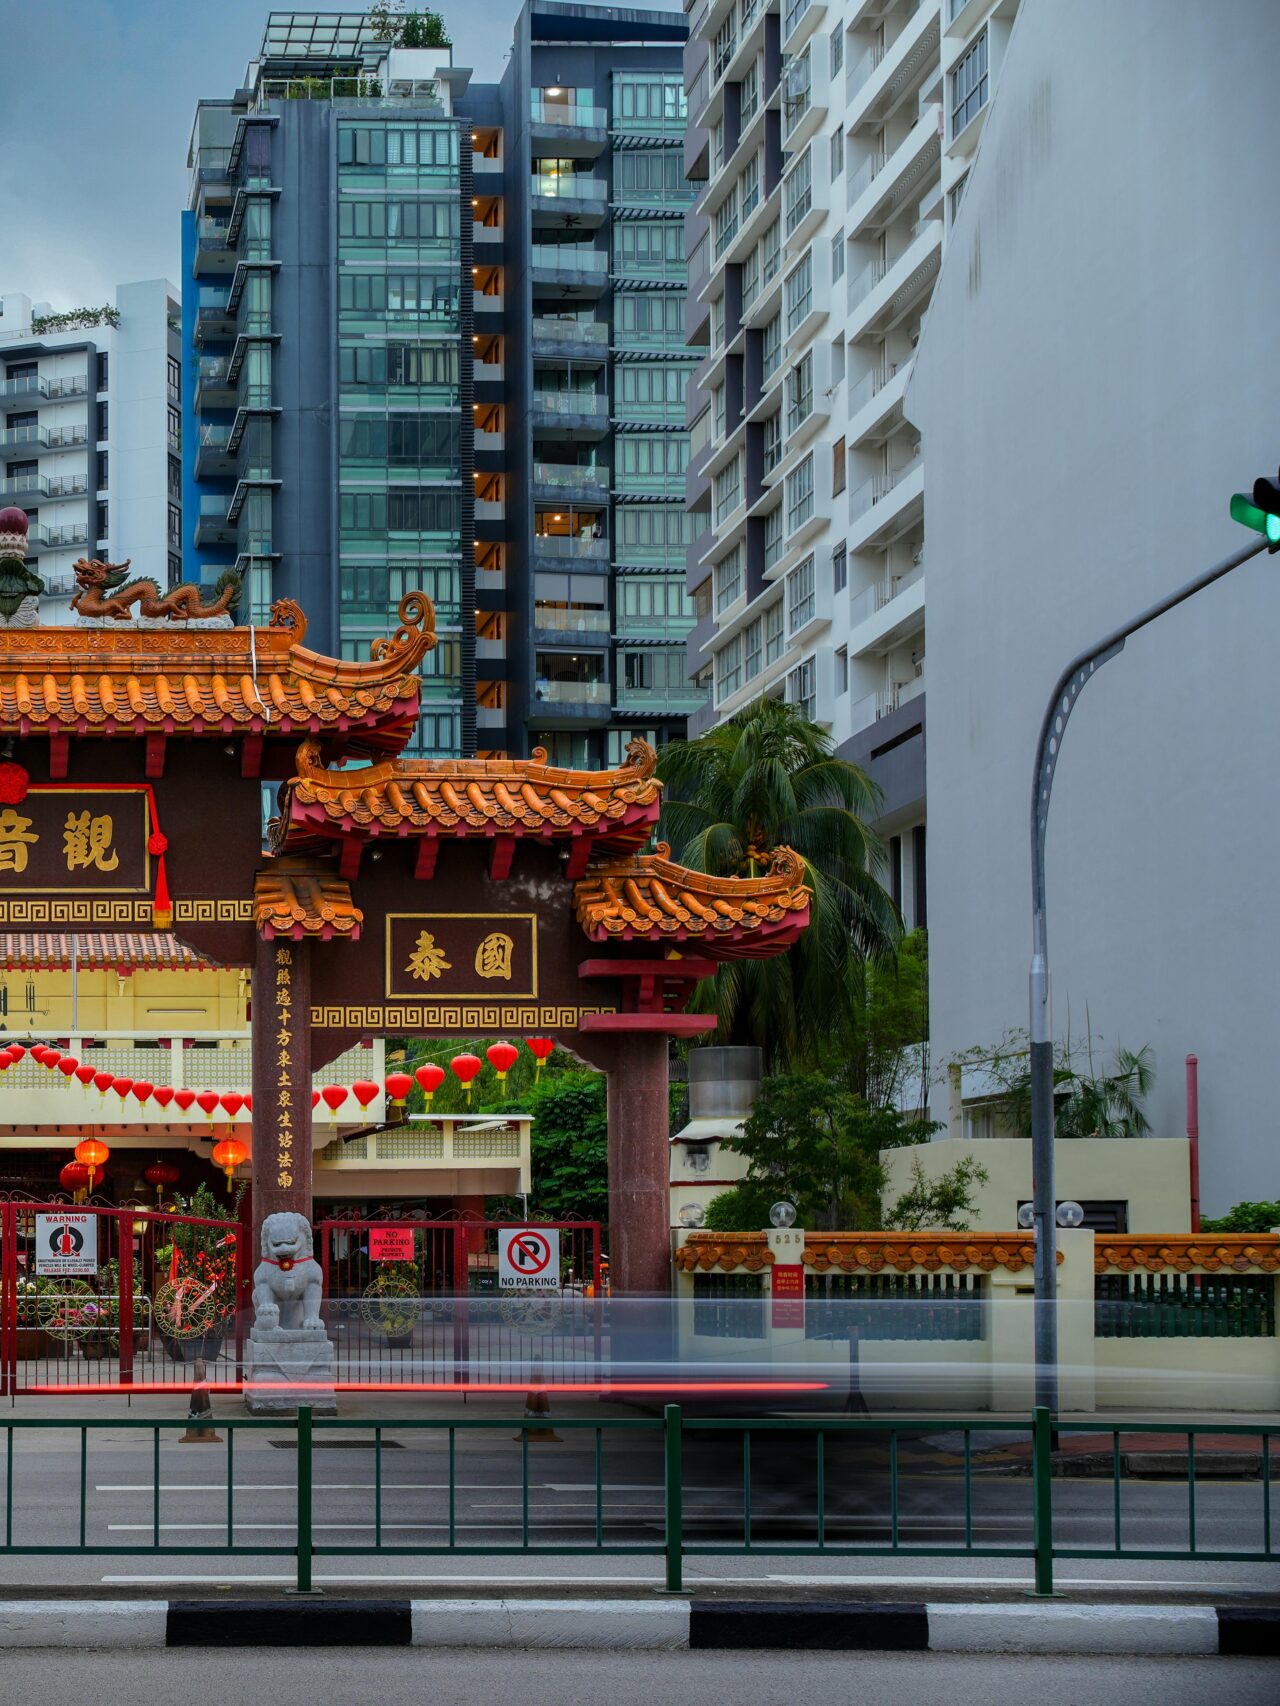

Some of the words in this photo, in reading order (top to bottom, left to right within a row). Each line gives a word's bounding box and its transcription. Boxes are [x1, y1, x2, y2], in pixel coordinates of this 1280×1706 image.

[45, 1215, 88, 1223] WARNING
[385, 1231, 399, 1239] NO
[775, 1234, 801, 1244] 525
[373, 1238, 411, 1246] PARKING
[501, 1277, 515, 1286] NO
[516, 1277, 557, 1286] PARKING
